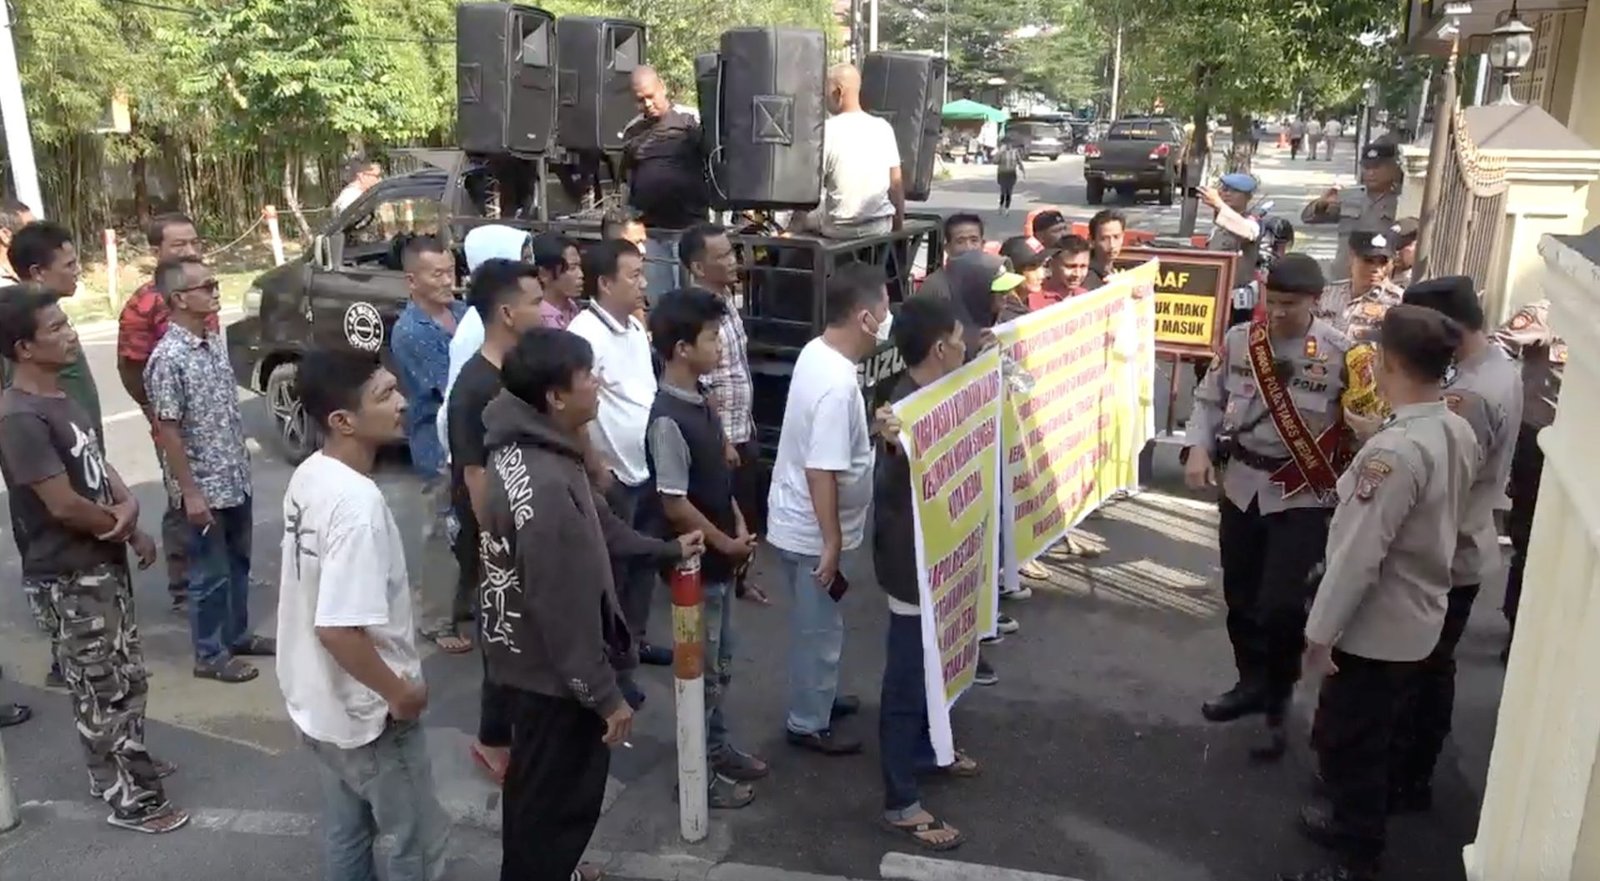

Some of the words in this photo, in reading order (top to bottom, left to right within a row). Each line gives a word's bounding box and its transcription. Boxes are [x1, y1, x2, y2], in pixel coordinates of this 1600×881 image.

[1154, 271, 1190, 289] AAF
[1155, 301, 1171, 315] UK
[1173, 302, 1208, 319] MAKO
[1161, 319, 1205, 336] MASUK
